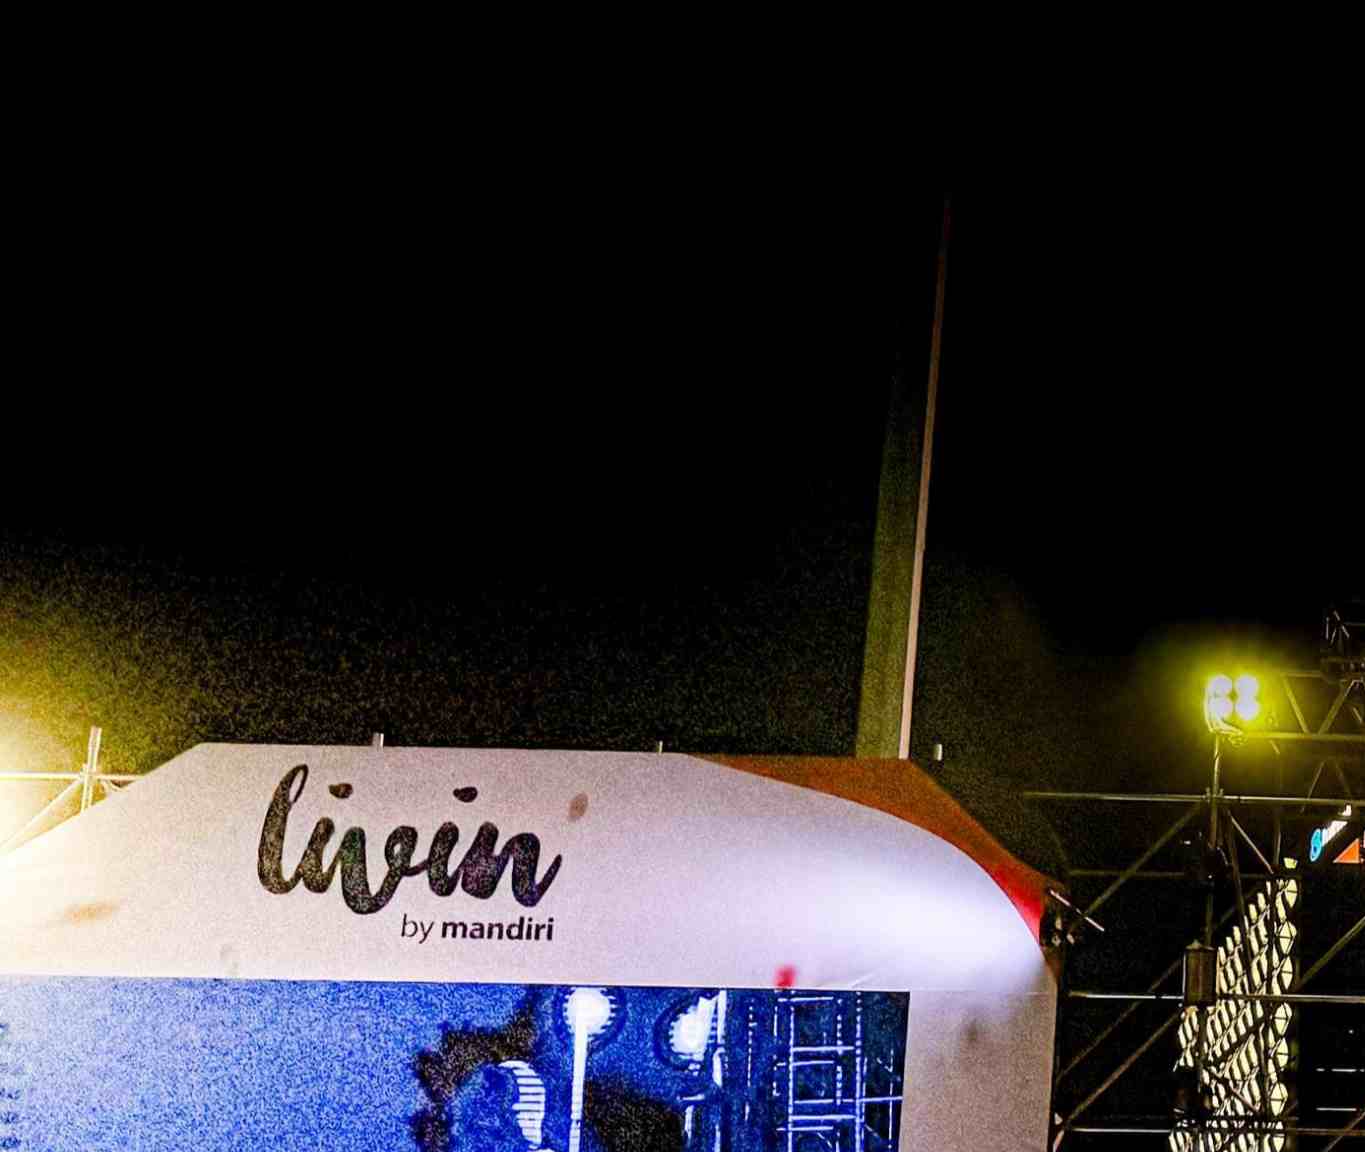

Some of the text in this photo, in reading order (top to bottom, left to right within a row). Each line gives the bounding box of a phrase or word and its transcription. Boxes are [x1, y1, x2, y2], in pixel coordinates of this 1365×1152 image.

[258, 764, 562, 915] livin
[401, 914, 554, 944] by mandiri
